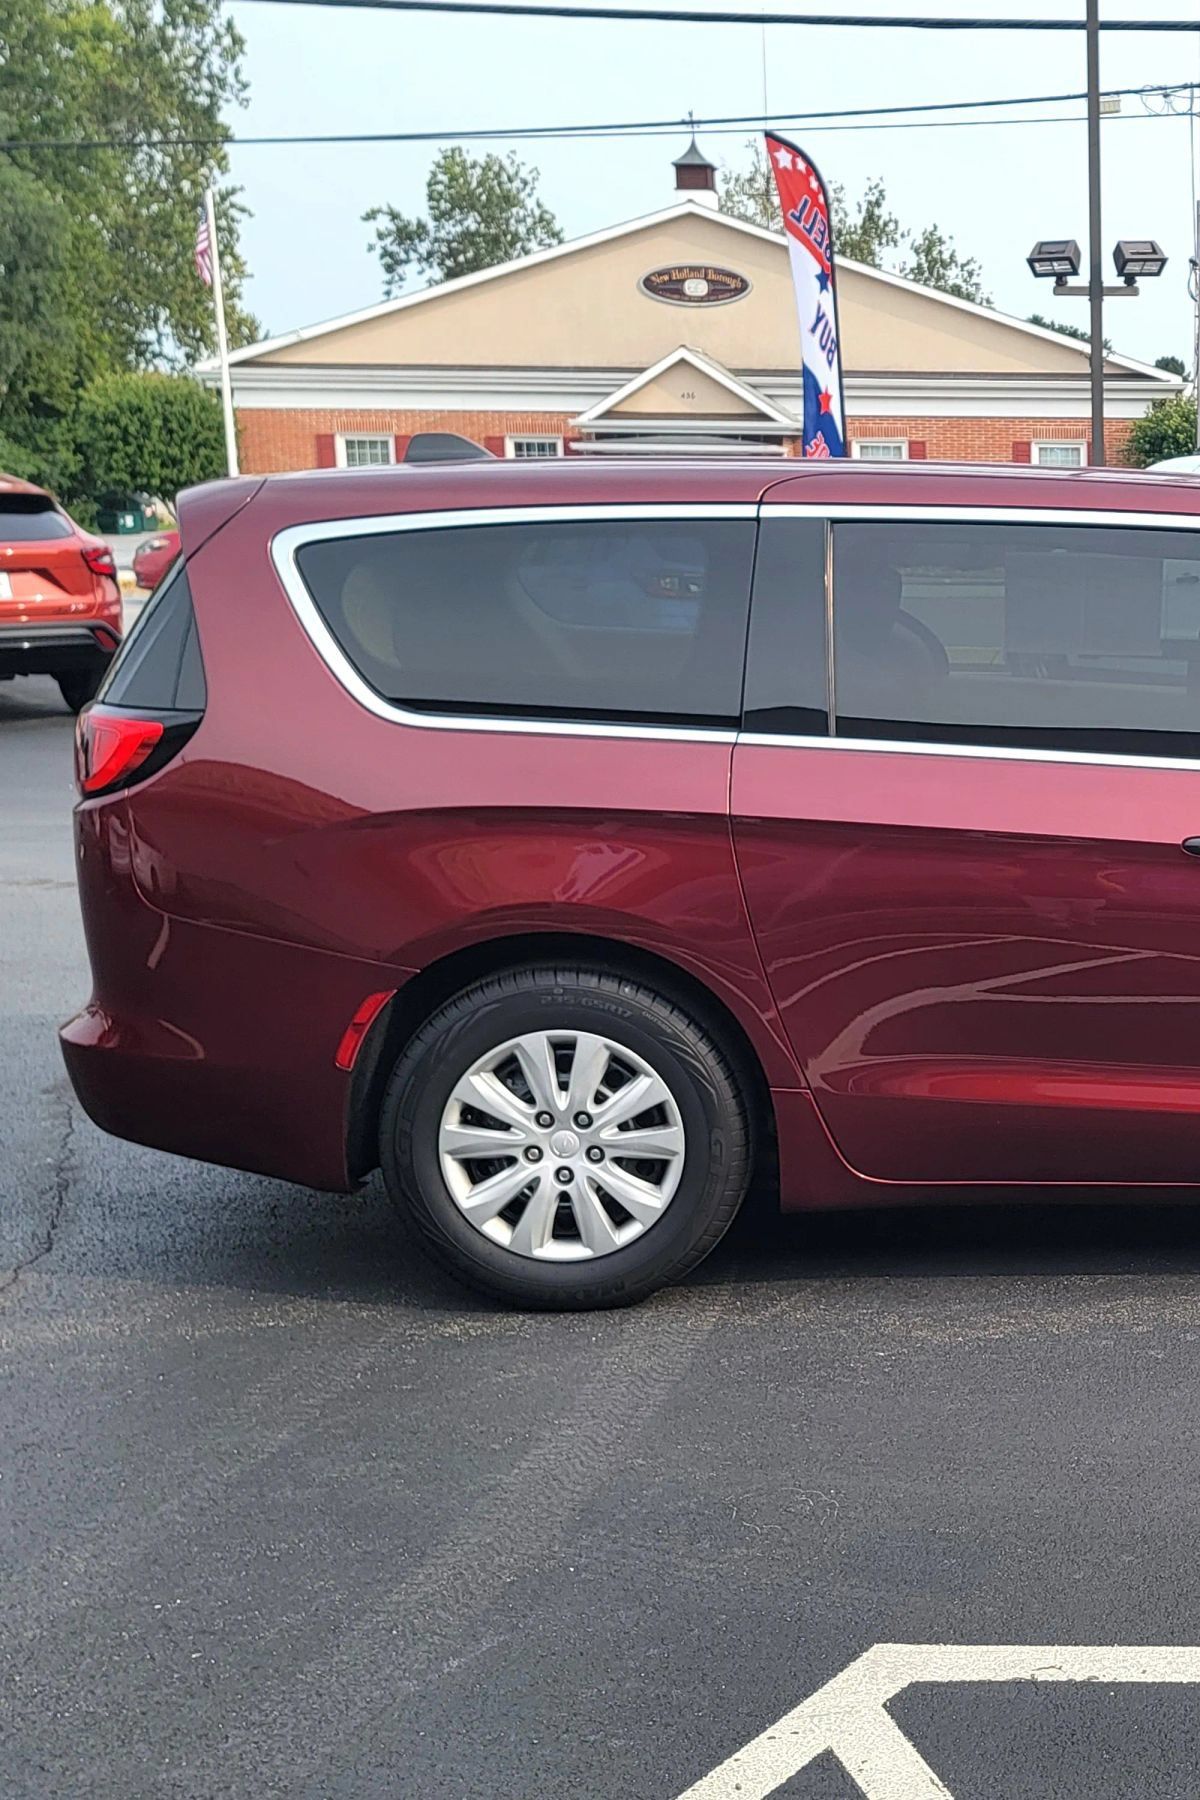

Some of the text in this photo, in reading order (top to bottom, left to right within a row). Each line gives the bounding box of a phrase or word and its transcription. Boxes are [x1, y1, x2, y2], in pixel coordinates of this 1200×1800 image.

[649, 267, 742, 289] New Holland Borough
